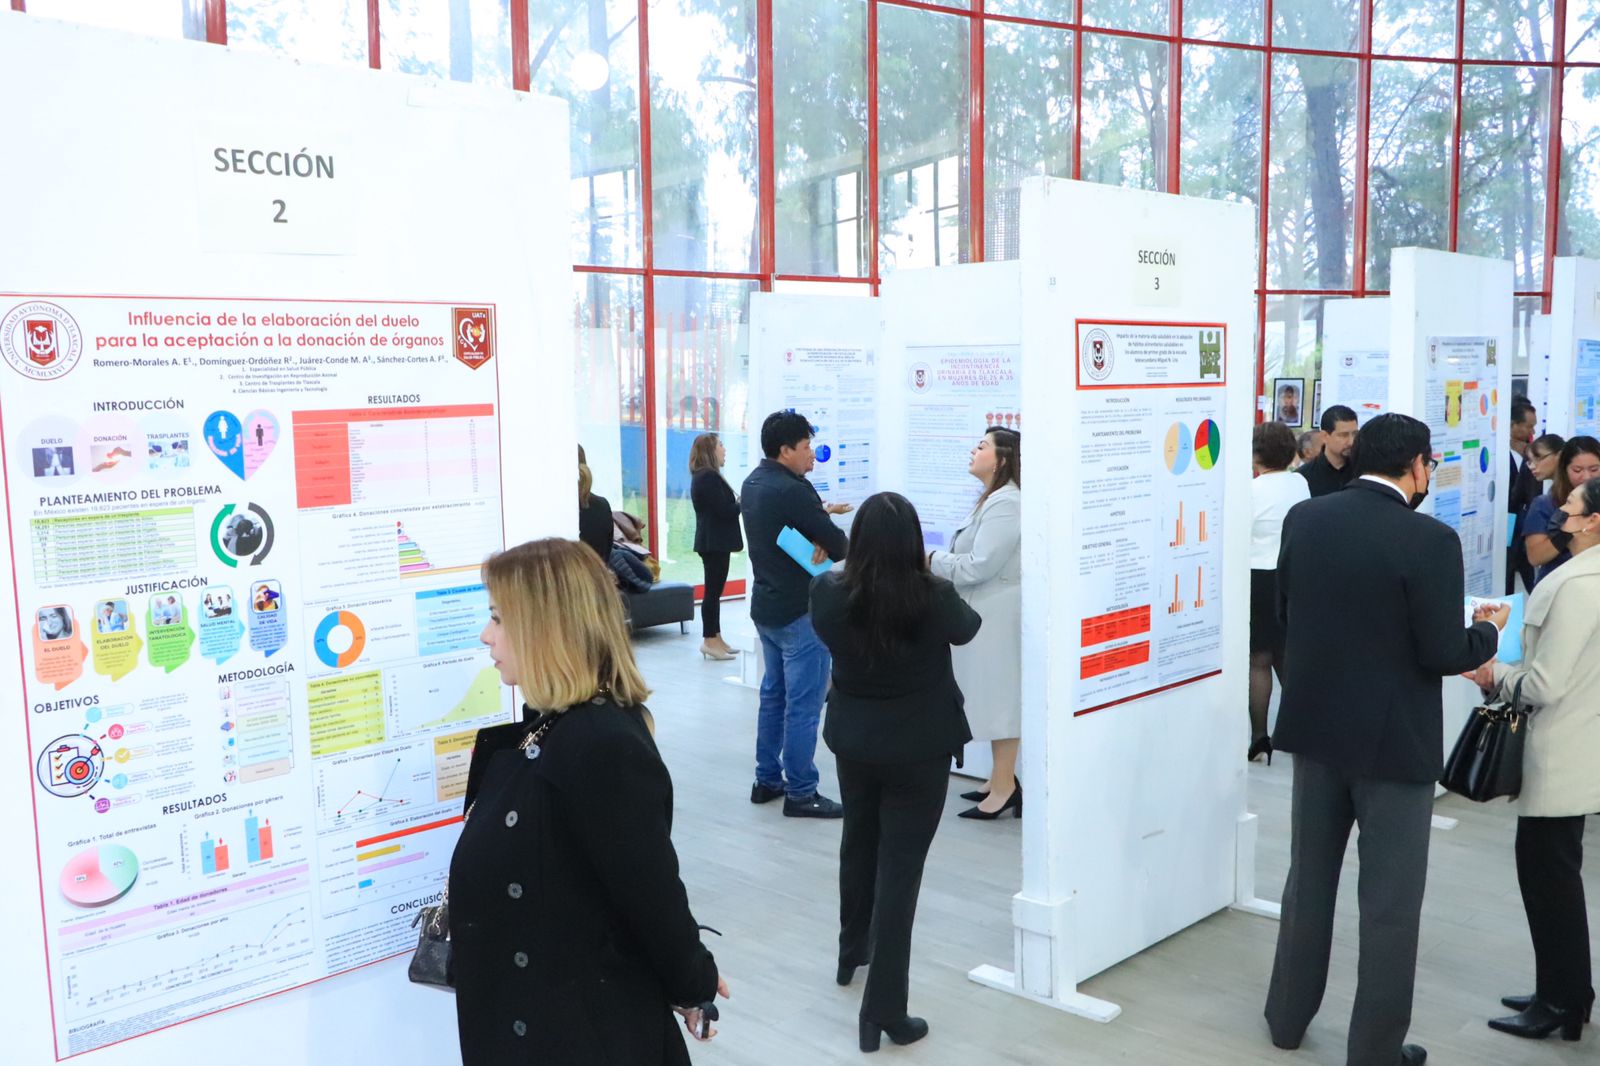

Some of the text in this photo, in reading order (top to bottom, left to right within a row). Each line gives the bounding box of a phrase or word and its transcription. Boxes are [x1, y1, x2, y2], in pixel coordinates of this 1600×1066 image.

[213, 147, 335, 179] SECCIÓN
[271, 199, 288, 223] 2
[1137, 249, 1176, 266] SECCIÓN
[1153, 277, 1160, 290] 3
[128, 312, 420, 328] Influencia de la elaboración del duelo
[96, 332, 444, 350] para la aceptación a la donación de órganos
[93, 358, 170, 367] Romero-Morales
[171, 359, 181, 367] A.
[199, 356, 282, 367] Domínguez-Ordóñez
[299, 356, 349, 366] Juárez-Conde
[350, 356, 361, 365] M.
[376, 355, 429, 364] Sánchez-Cortes
[429, 355, 437, 363] A.
[93, 398, 185, 413] INTRODUCCIÓN
[367, 394, 421, 404] RESULTADOS
[93, 434, 128, 443] DONACIÓN
[146, 432, 190, 440] TRASPLANTES
[39, 484, 221, 507] PLANTEAMIENTO DEL PROBLEMA
[125, 576, 208, 595] JUSTIFICACIÓN
[111, 641, 129, 649] DUELO
[217, 661, 295, 684] METODOLOGÍA
[34, 695, 100, 714] OBJETIVOS
[161, 793, 228, 816] RESULTADOS
[194, 811, 215, 820] Gráfica
[222, 801, 254, 813] Donaciones
[254, 799, 265, 807] por
[265, 794, 284, 804] género
[67, 839, 92, 848] Gráfica
[99, 831, 114, 840] Total
[124, 823, 157, 834] entrevistas
[391, 891, 446, 915] CONCLUSIÓ
